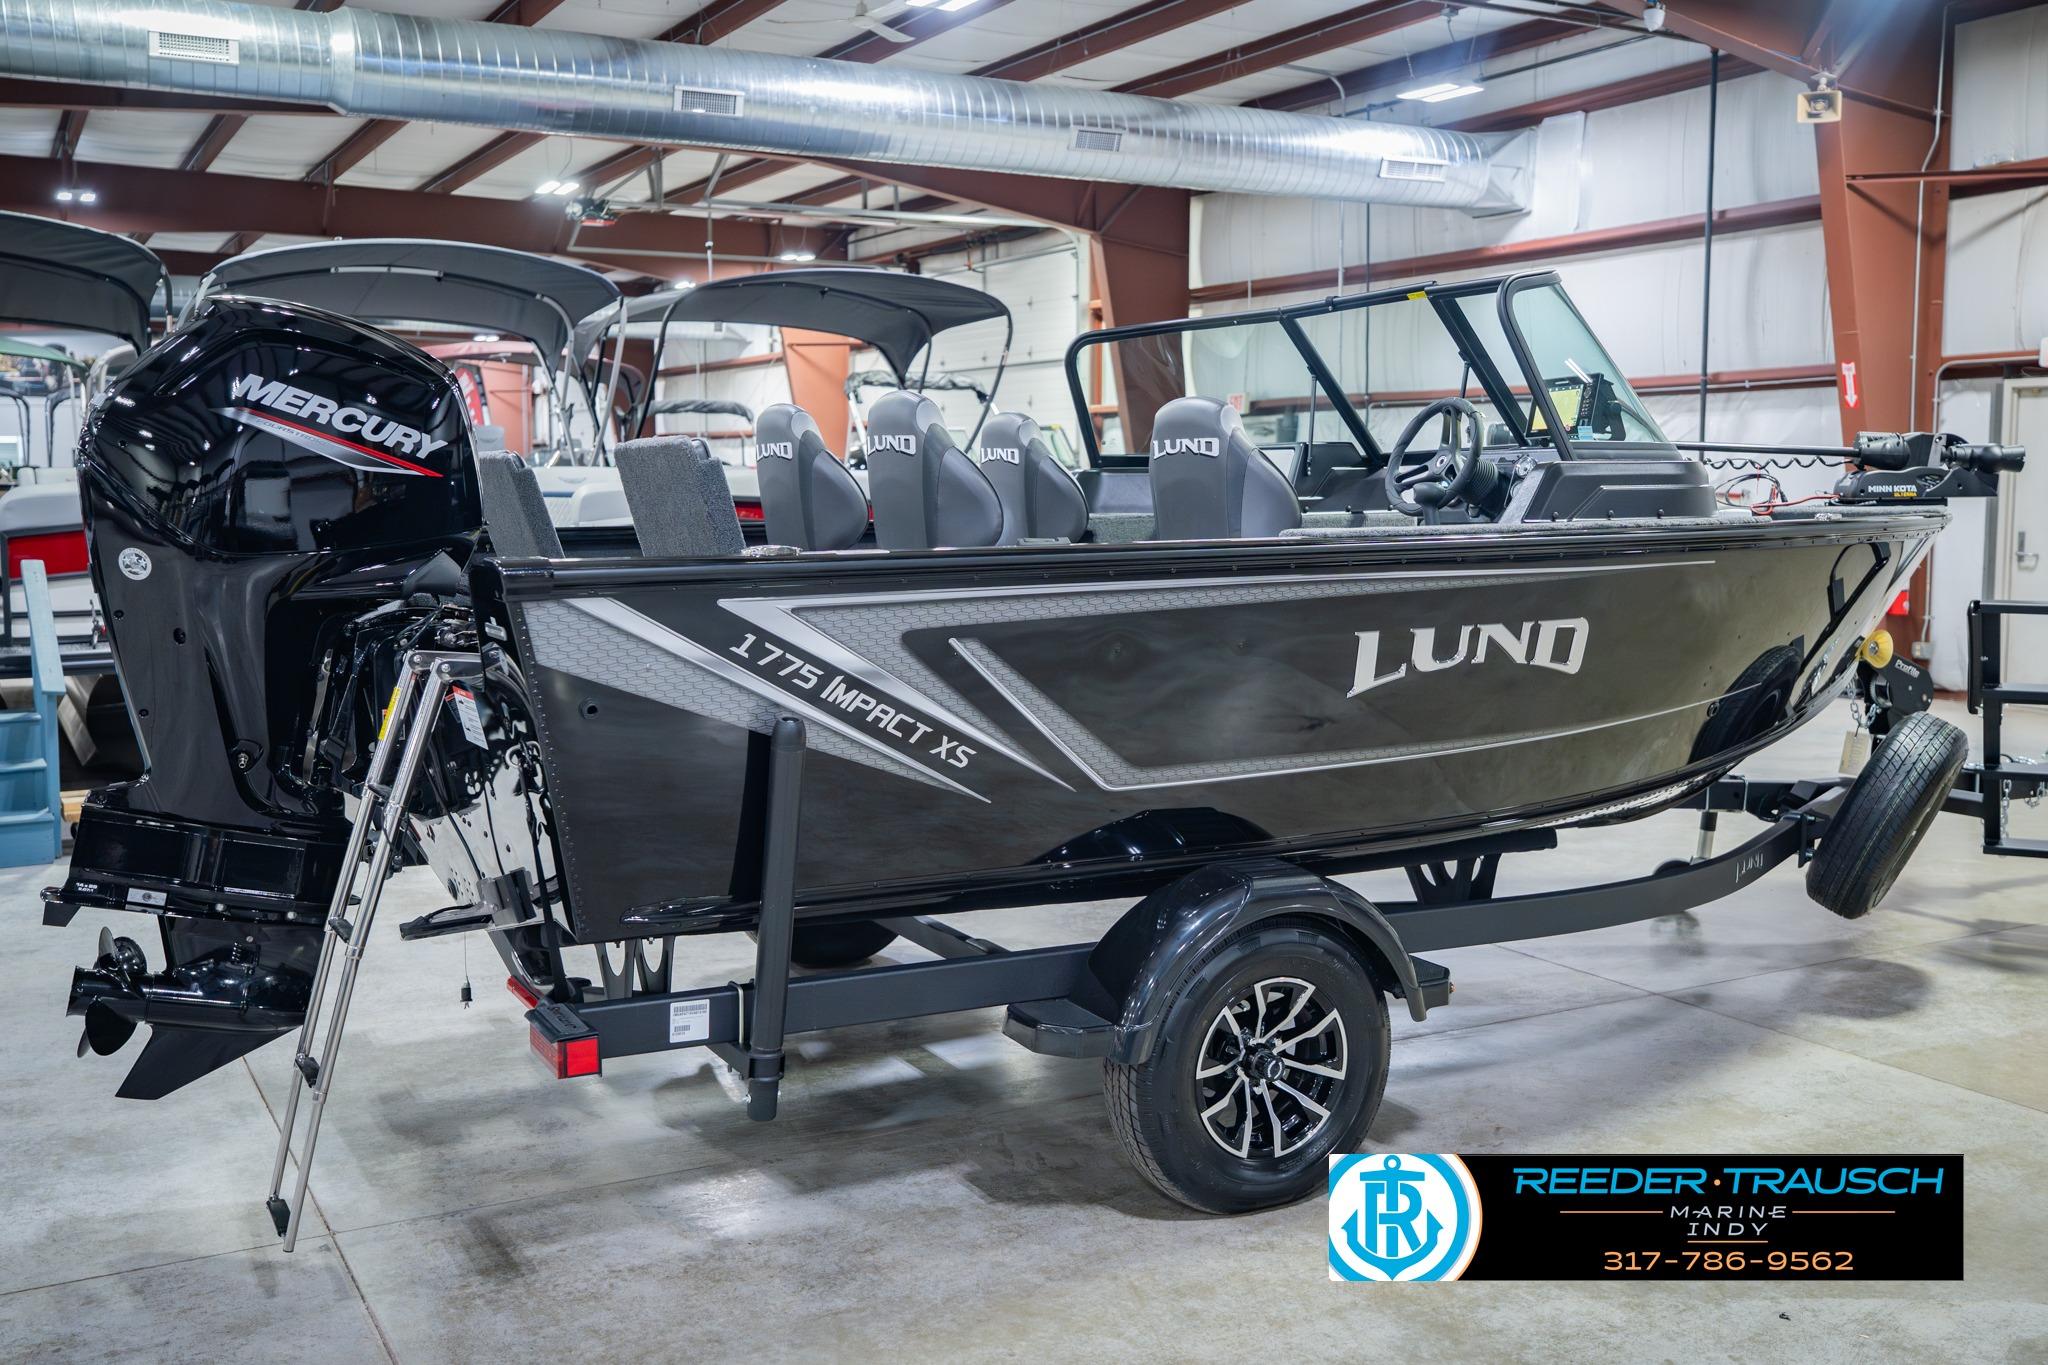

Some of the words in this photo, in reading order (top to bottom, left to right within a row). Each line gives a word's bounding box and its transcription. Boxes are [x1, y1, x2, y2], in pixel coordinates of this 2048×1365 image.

[235, 374, 448, 459] MERCURY
[756, 442, 792, 461] LUND
[867, 435, 916, 456] LUND
[1153, 437, 1219, 460] LUND
[981, 448, 1019, 465] LUND
[1893, 484, 1917, 492] KOTA
[1346, 617, 1590, 698] LUND
[1895, 659, 1920, 678] Profile
[729, 632, 824, 690] 1775
[819, 675, 934, 744] IMPACT
[929, 735, 977, 768] XS
